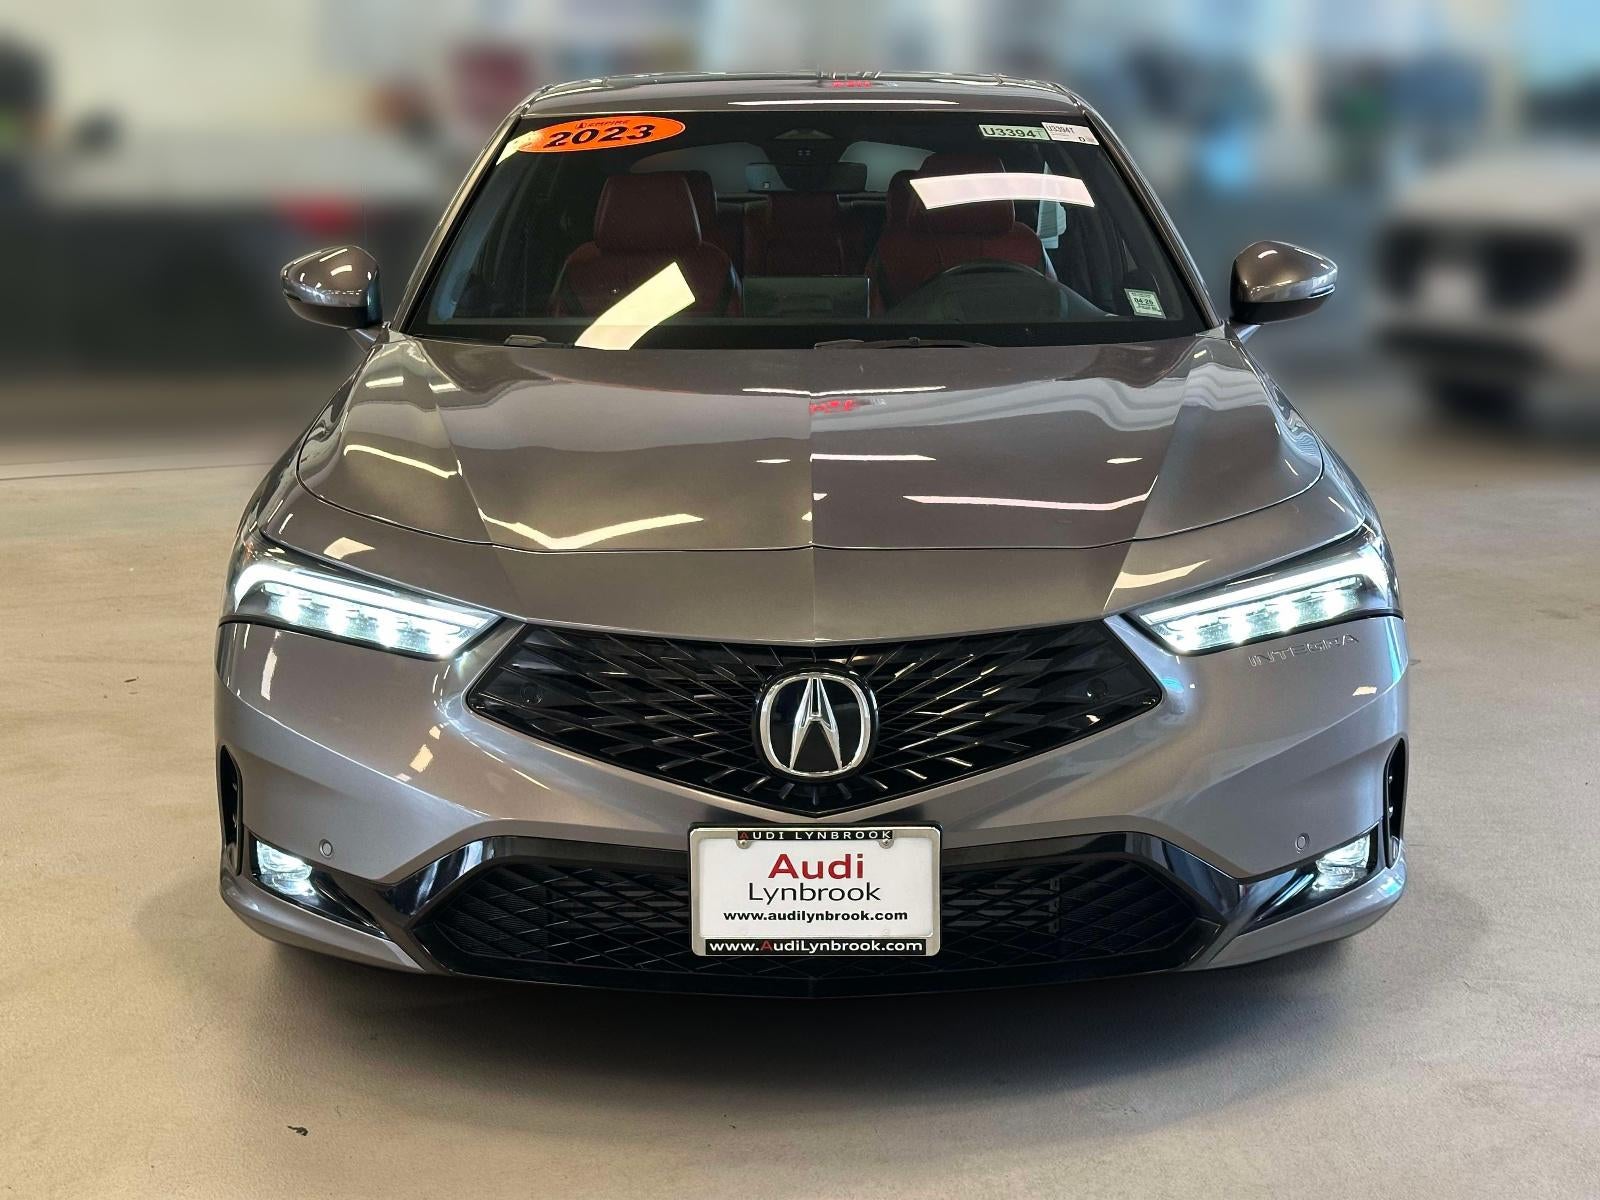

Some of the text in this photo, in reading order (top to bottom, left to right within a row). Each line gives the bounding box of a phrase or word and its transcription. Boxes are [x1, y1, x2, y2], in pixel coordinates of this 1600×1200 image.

[543, 124, 656, 149] 2023
[1248, 633, 1360, 667] INTEGRA
[739, 830, 892, 840] AUDI LYNBROOK
[768, 853, 864, 880] Audi
[748, 882, 881, 905] Lynbrook
[723, 910, 908, 924] www.audilynbrook.com
[709, 938, 923, 955] www.AudiLynbrook.com
